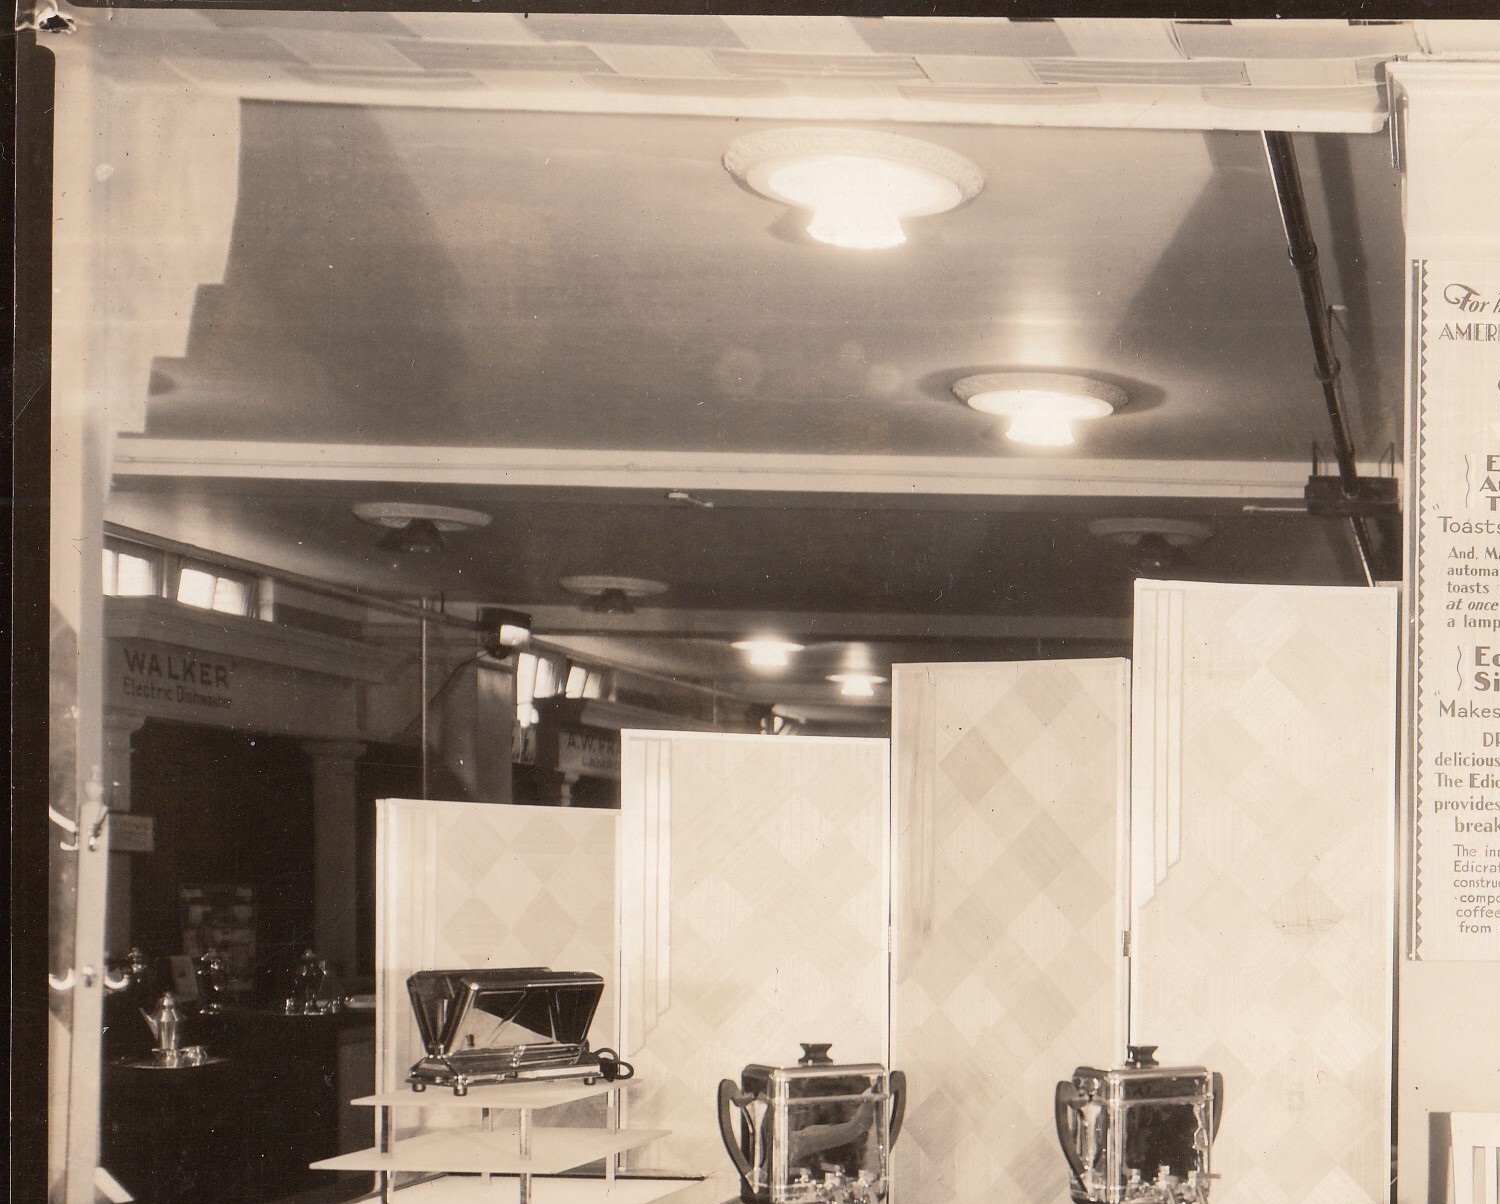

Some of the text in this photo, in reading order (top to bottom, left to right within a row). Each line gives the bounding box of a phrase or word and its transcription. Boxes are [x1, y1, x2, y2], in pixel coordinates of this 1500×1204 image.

[1443, 283, 1490, 313] For
[1447, 581, 1490, 594] toasts
[1445, 599, 1463, 610] at
[1467, 601, 1499, 611] once
[1447, 617, 1456, 628] a
[122, 648, 230, 689] WALKER
[122, 676, 173, 701] Electric
[1434, 772, 1463, 788] The
[1453, 844, 1477, 857] The
[1459, 921, 1491, 933] from
